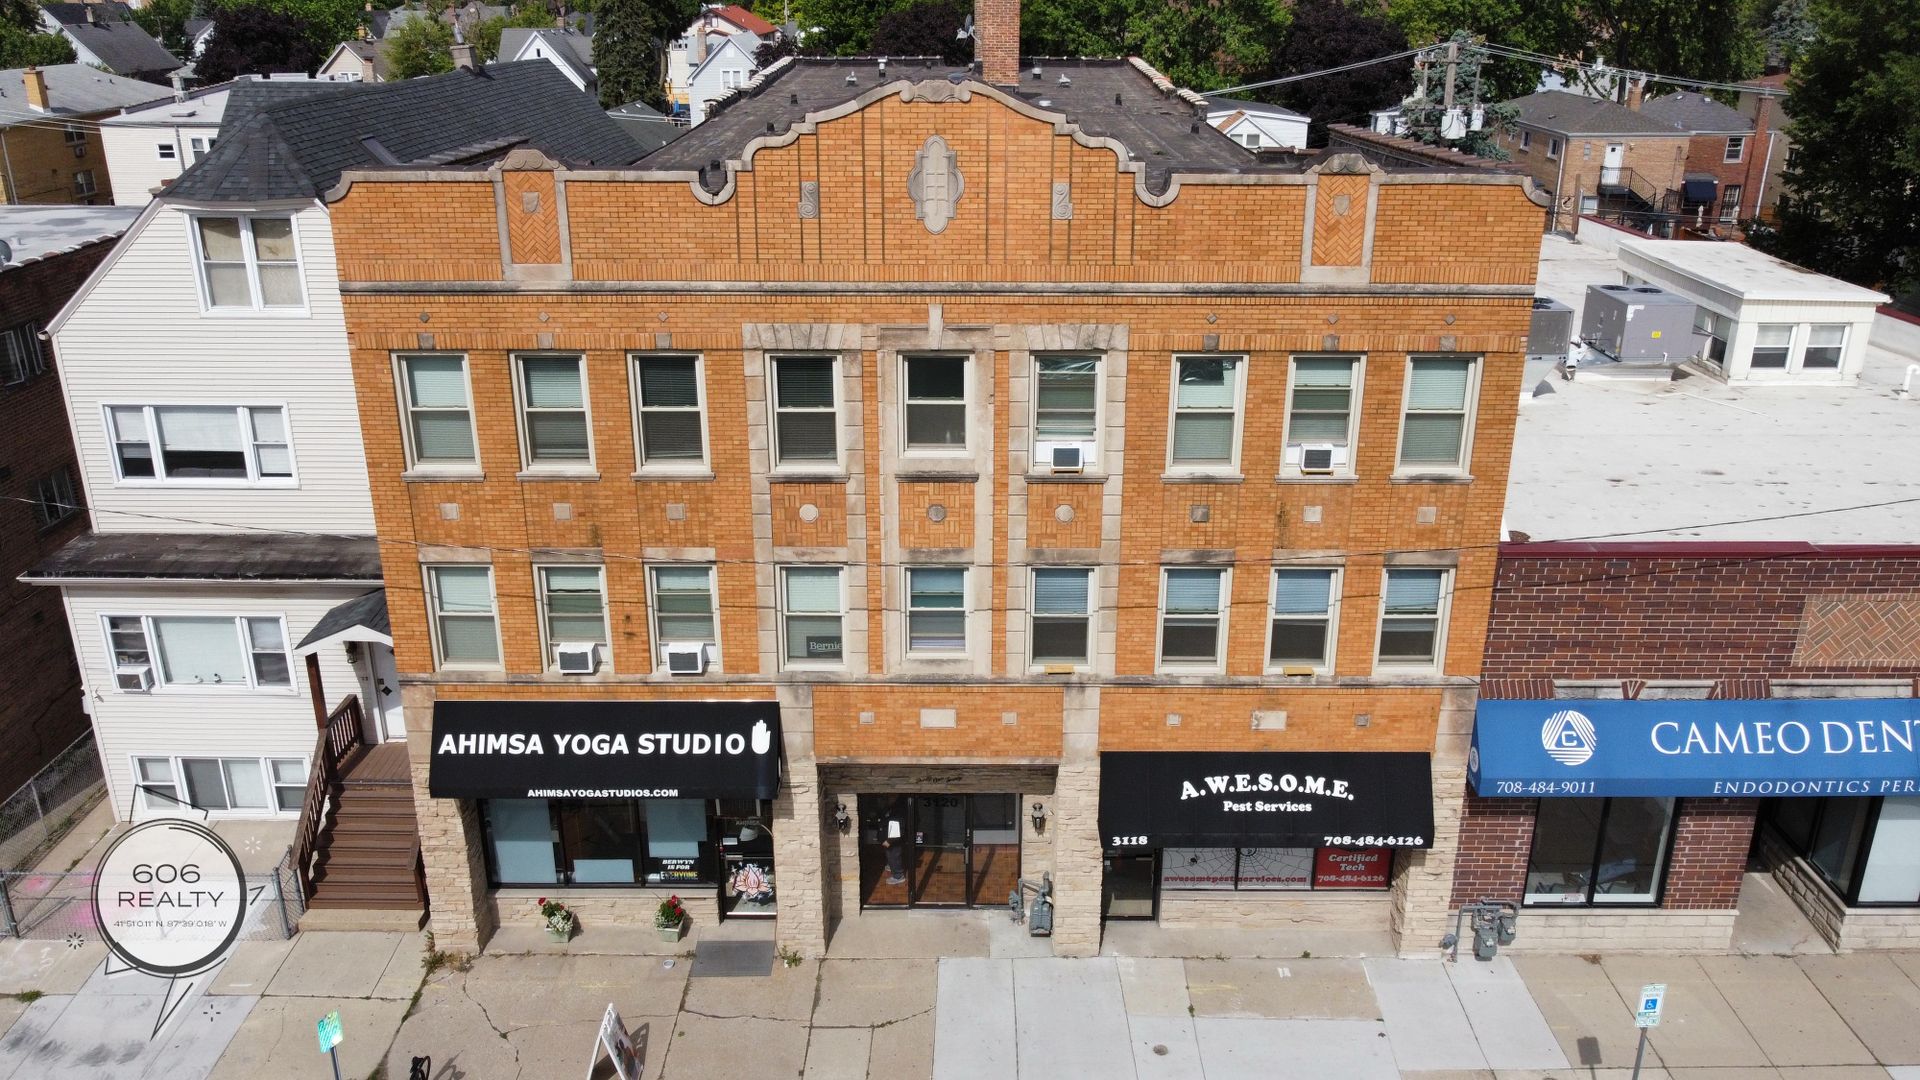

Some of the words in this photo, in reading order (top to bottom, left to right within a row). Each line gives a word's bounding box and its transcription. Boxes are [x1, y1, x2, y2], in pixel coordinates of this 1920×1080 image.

[809, 641, 842, 651] Bernie
[1650, 721, 1811, 755] CAMEO
[438, 734, 543, 755] AHIMSA
[553, 734, 629, 755] YOGA
[638, 734, 746, 755] STUDIO
[1180, 773, 1354, 801] A.W.E.S.O.M.E.
[1497, 781, 1595, 794] 708-484-9011
[1713, 780, 1871, 794] ENDODONTICS
[1880, 779, 1920, 793] PER
[527, 789, 679, 798] AHIMSAYOGASTUDIOS.COM
[1223, 801, 1252, 812] Pest
[1255, 801, 1312, 812] Services
[1112, 836, 1148, 846] 3118
[1323, 836, 1424, 847] 708-484-6126
[1328, 854, 1378, 863] Certified
[1339, 863, 1365, 871] Tech
